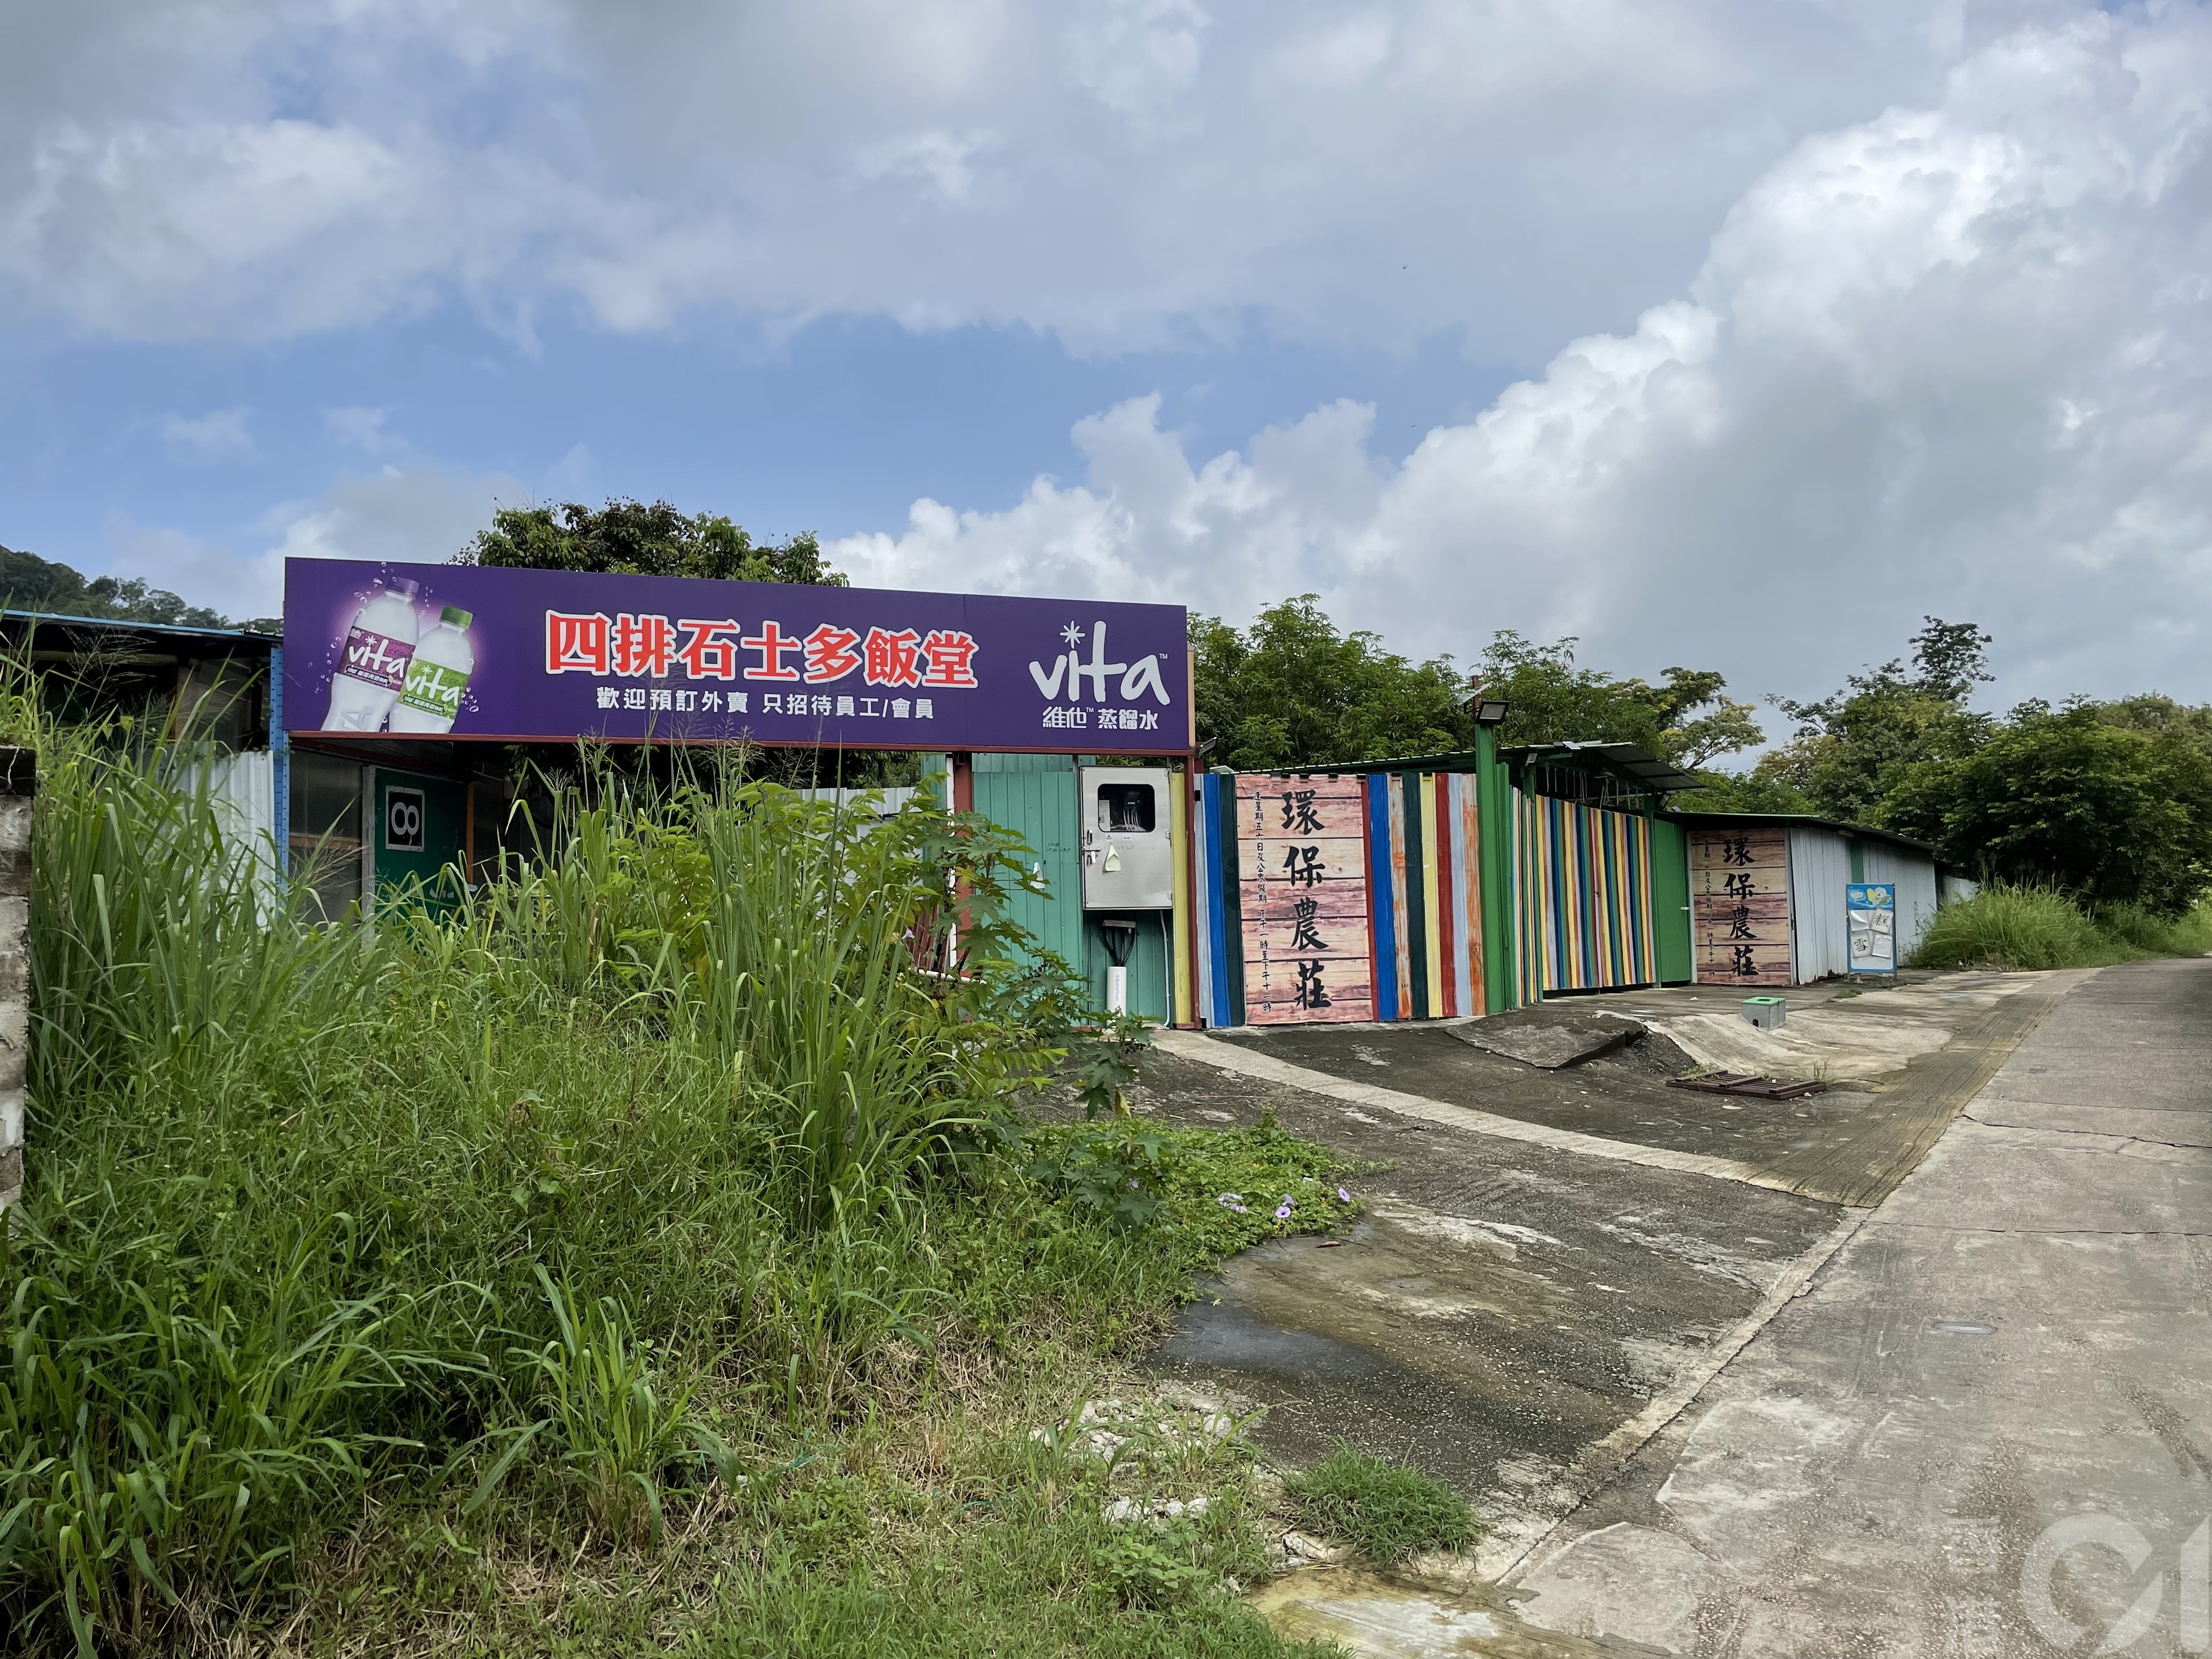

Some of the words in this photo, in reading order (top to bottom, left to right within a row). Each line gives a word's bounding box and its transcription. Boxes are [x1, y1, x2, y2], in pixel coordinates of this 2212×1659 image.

[545, 609, 979, 688] 四排石士多飯堂
[1029, 620, 1170, 706] vita
[596, 686, 748, 714] 歡迎預訂外賣
[762, 693, 935, 720] 只招待員工/會員
[1281, 789, 1331, 1011] 環保農莊
[1723, 837, 1759, 977] 環保農莊
[1854, 938, 1868, 952] 雪
